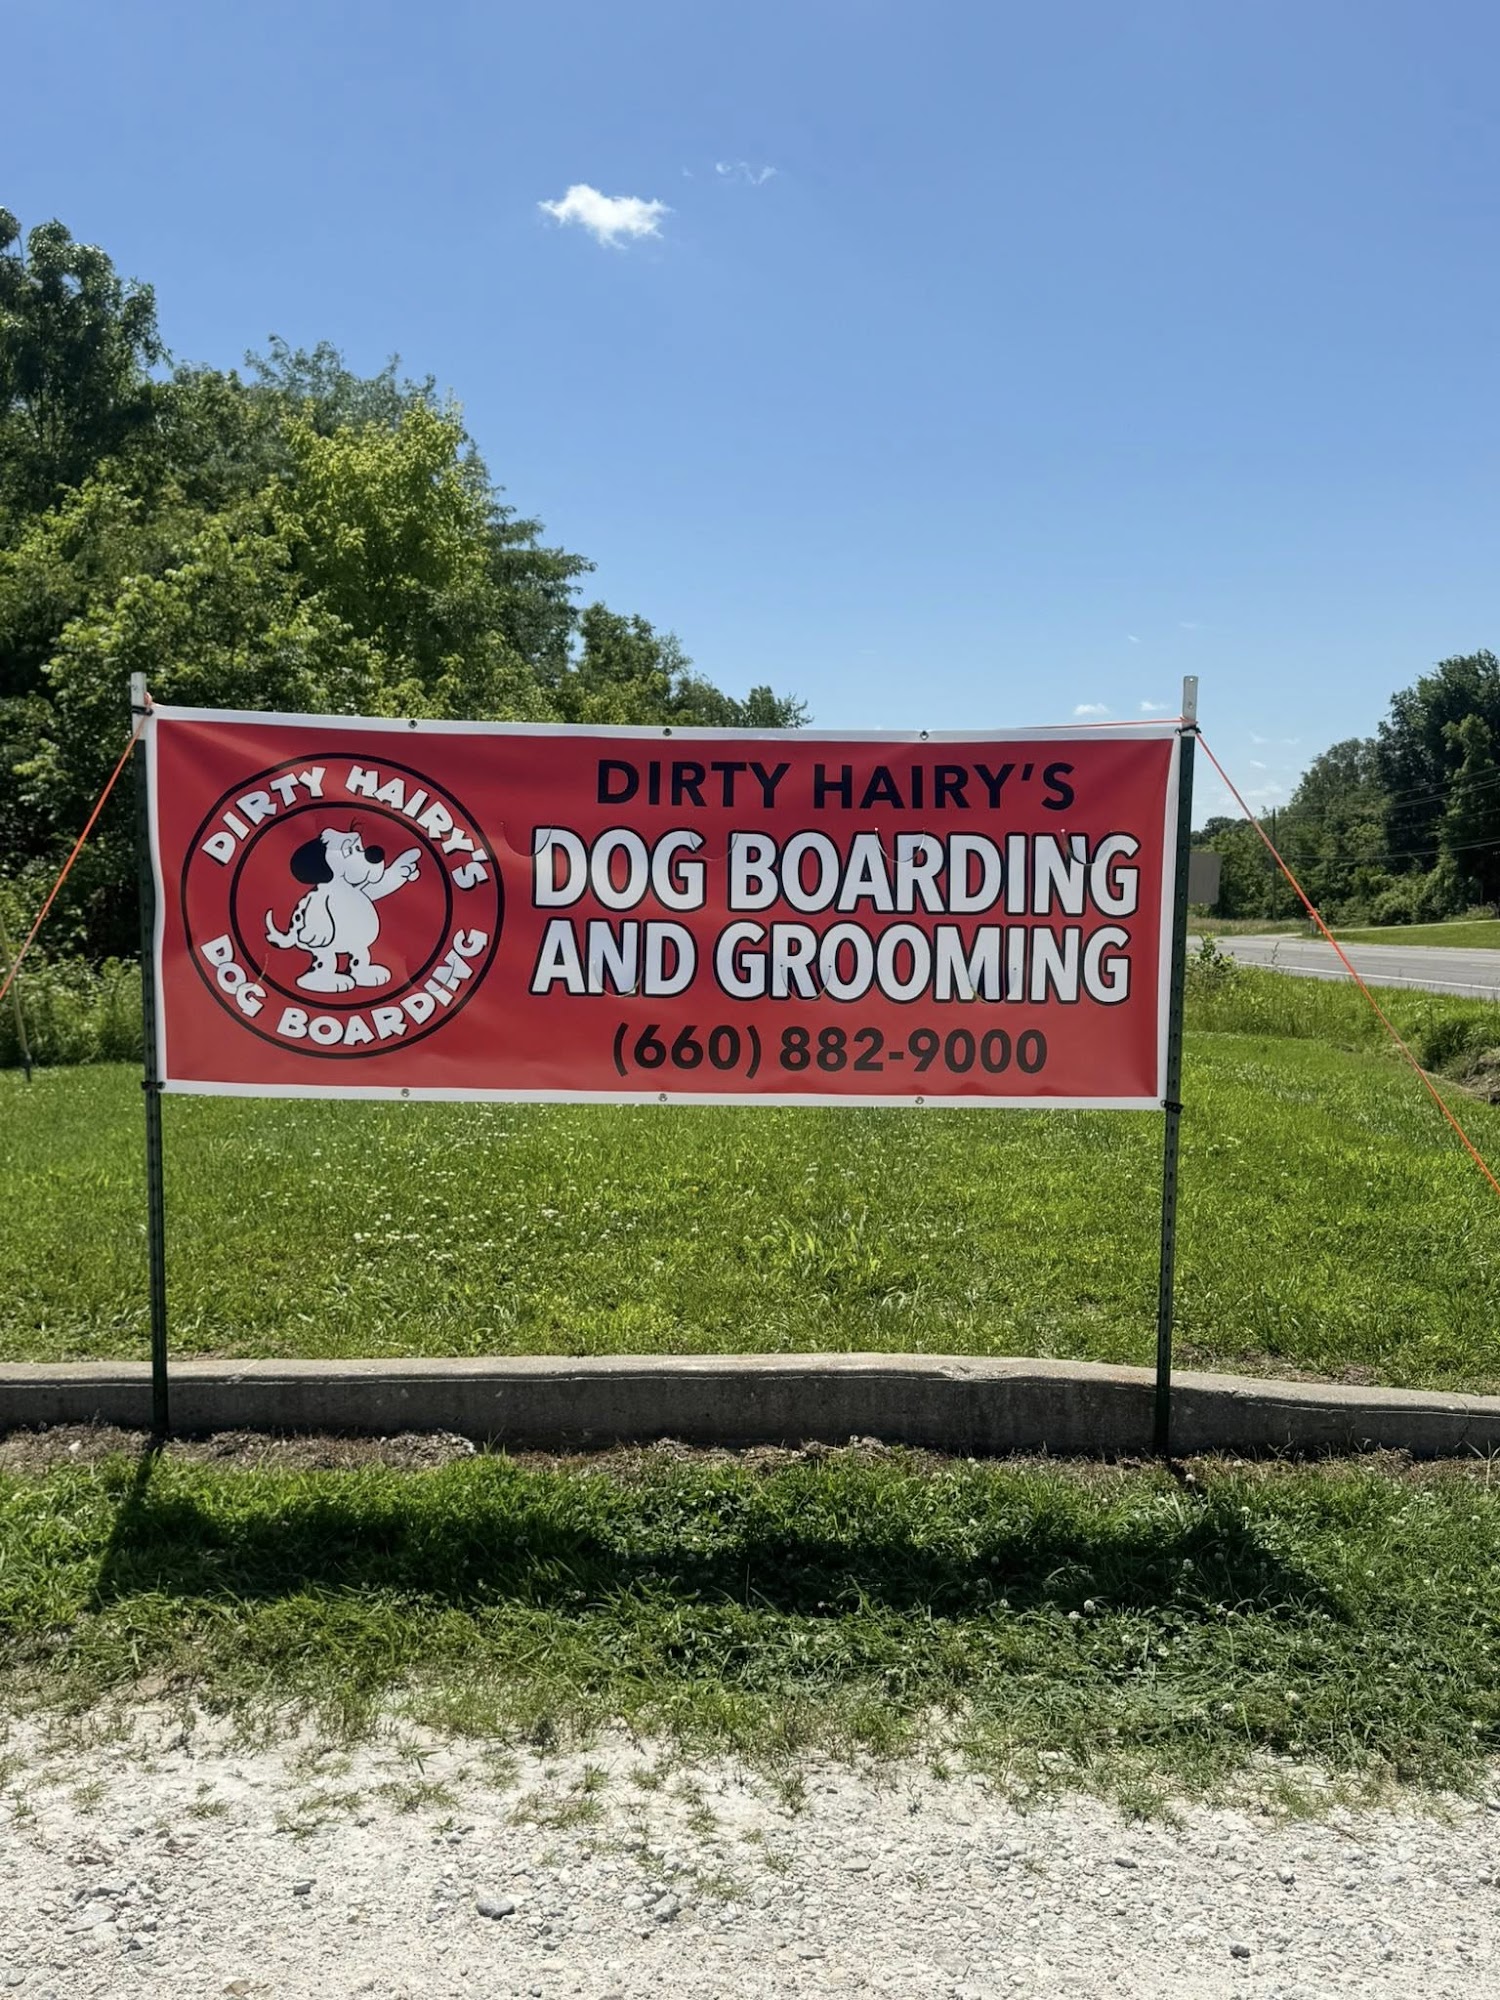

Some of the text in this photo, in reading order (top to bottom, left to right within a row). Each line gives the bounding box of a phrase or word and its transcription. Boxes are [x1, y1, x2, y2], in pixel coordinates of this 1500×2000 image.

[202, 765, 490, 889] DIRTY HAIRY'S
[597, 759, 1075, 811] DIRTY HAIRY'S
[532, 825, 1141, 918] DOG BOARDING
[200, 928, 488, 1046] DOG BOARDING
[529, 917, 1133, 1006] AND GROOMING
[613, 1022, 1047, 1079] (660) 882-9000
